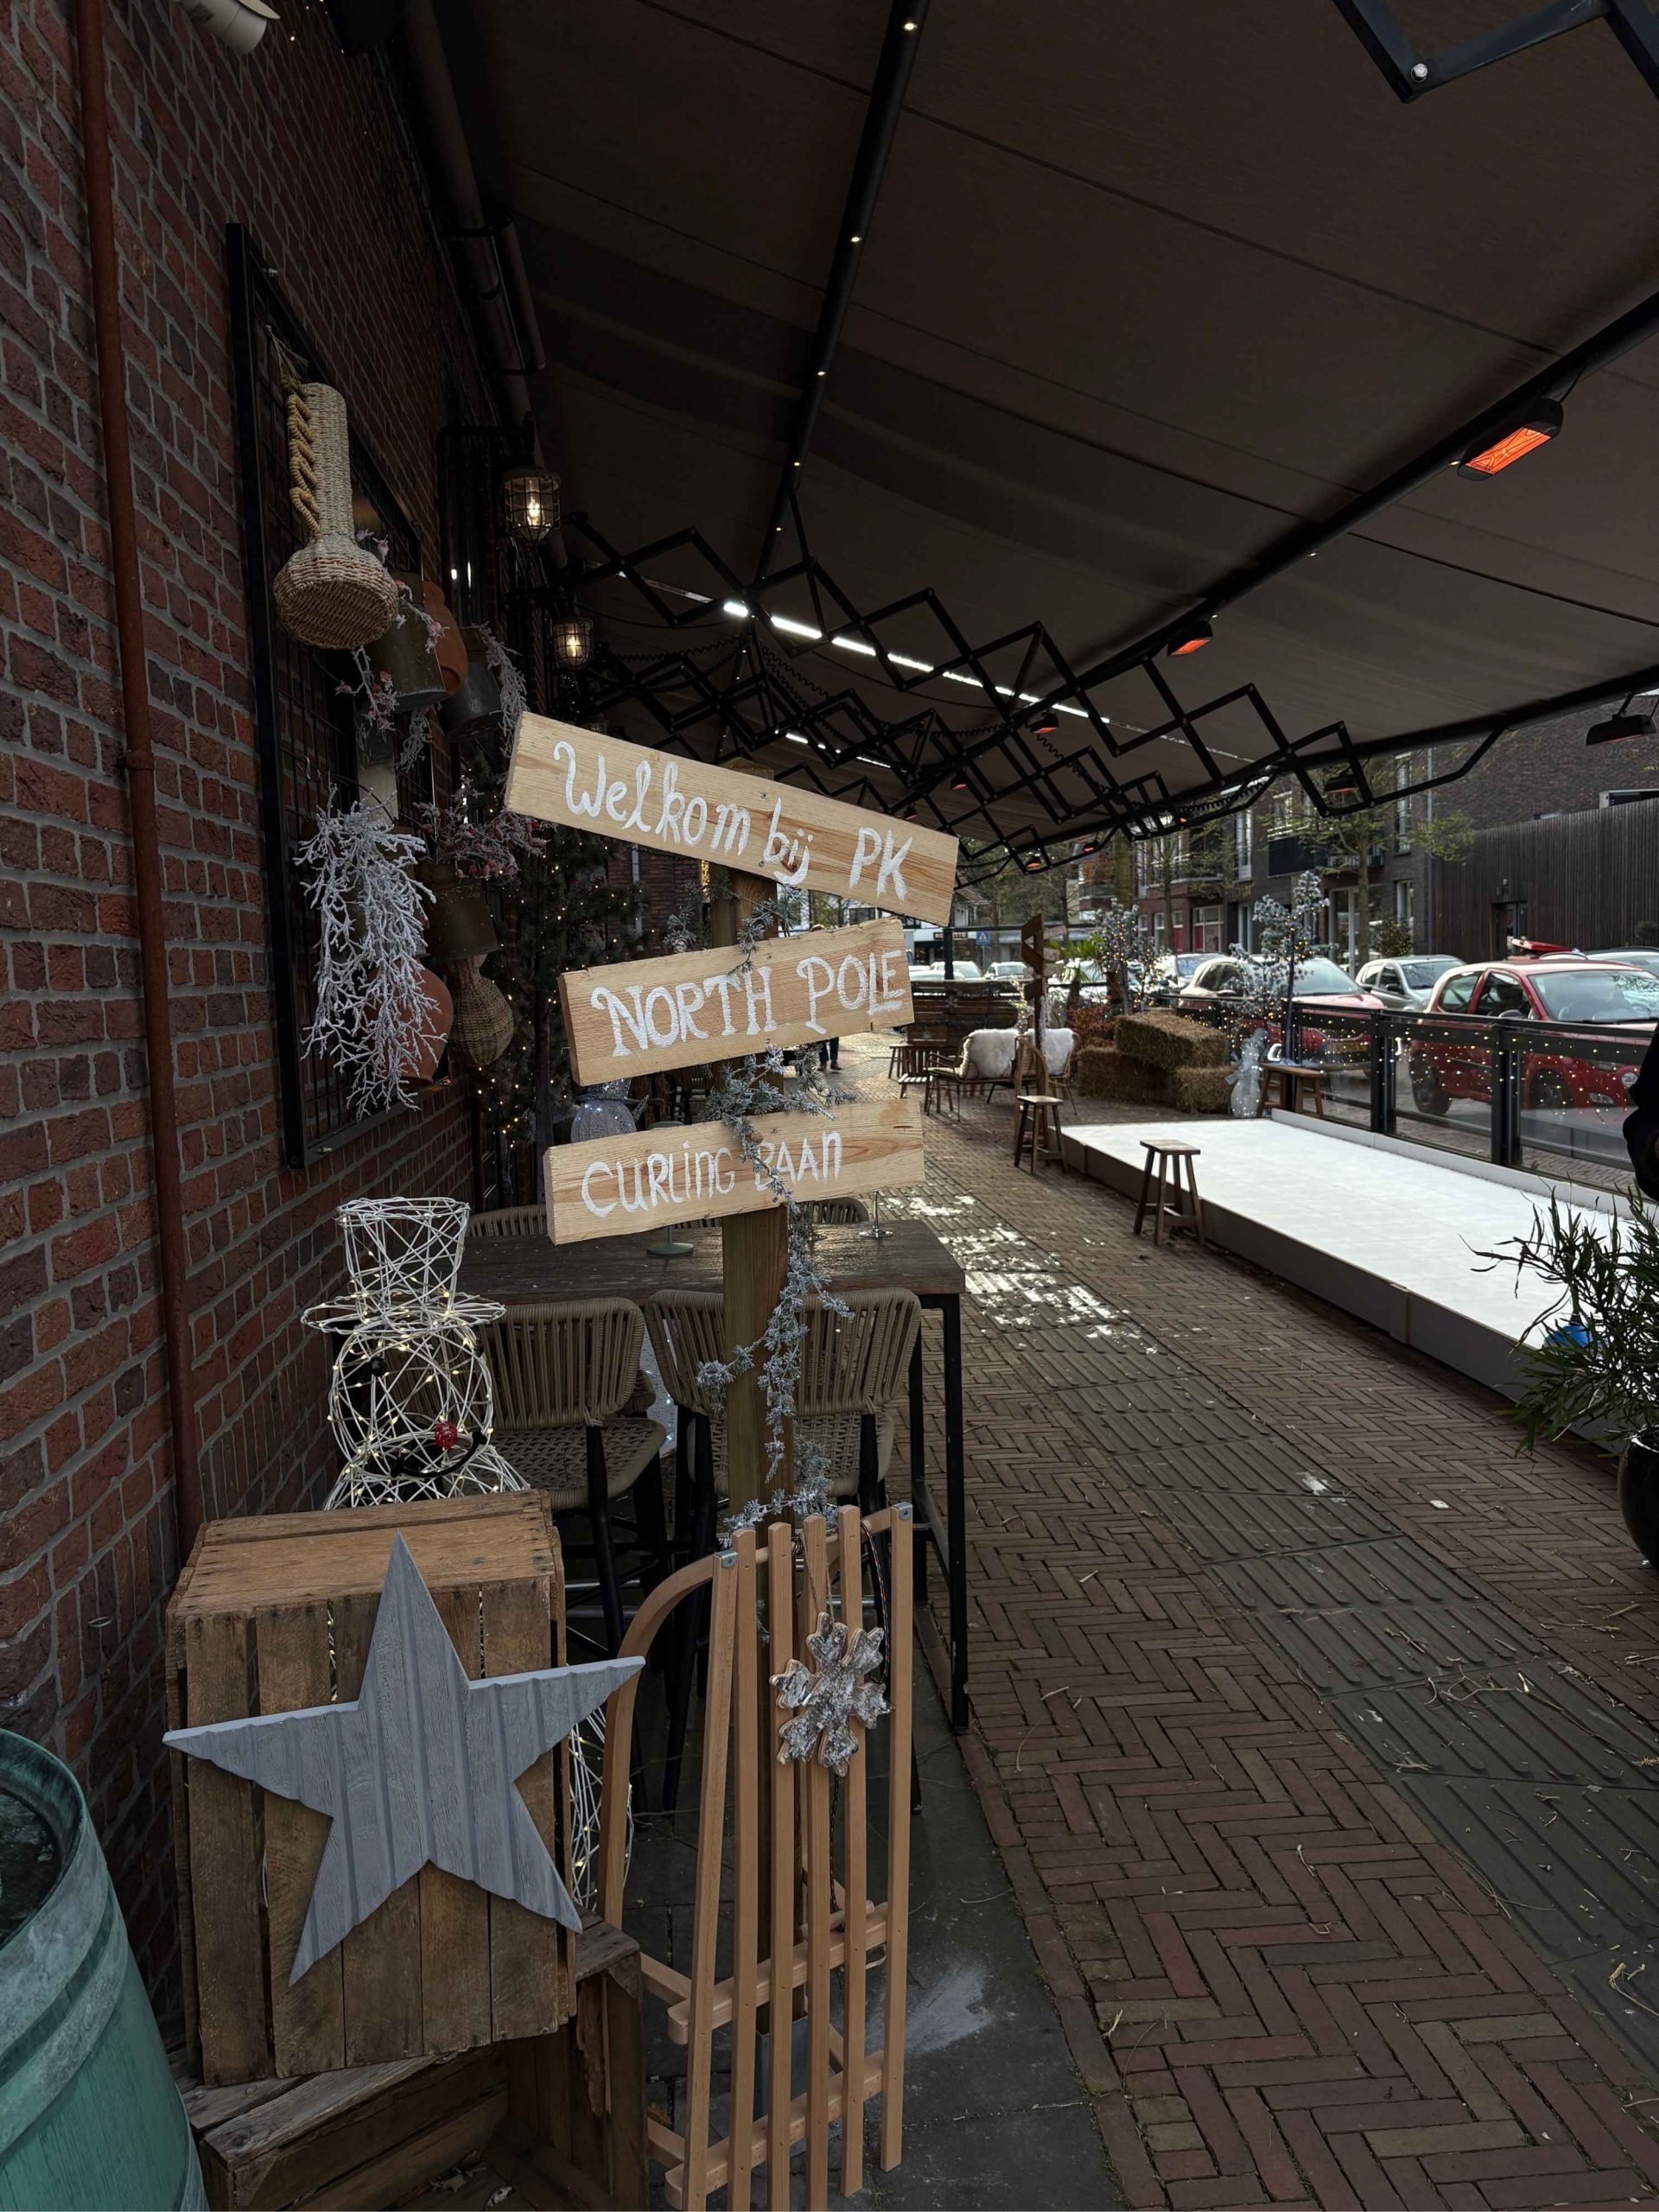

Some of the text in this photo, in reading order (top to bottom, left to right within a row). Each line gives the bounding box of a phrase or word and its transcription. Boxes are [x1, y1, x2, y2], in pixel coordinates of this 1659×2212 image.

[553, 741, 751, 855] Welkom
[849, 826, 914, 901] PK
[590, 950, 906, 1058] NORTH POLE
